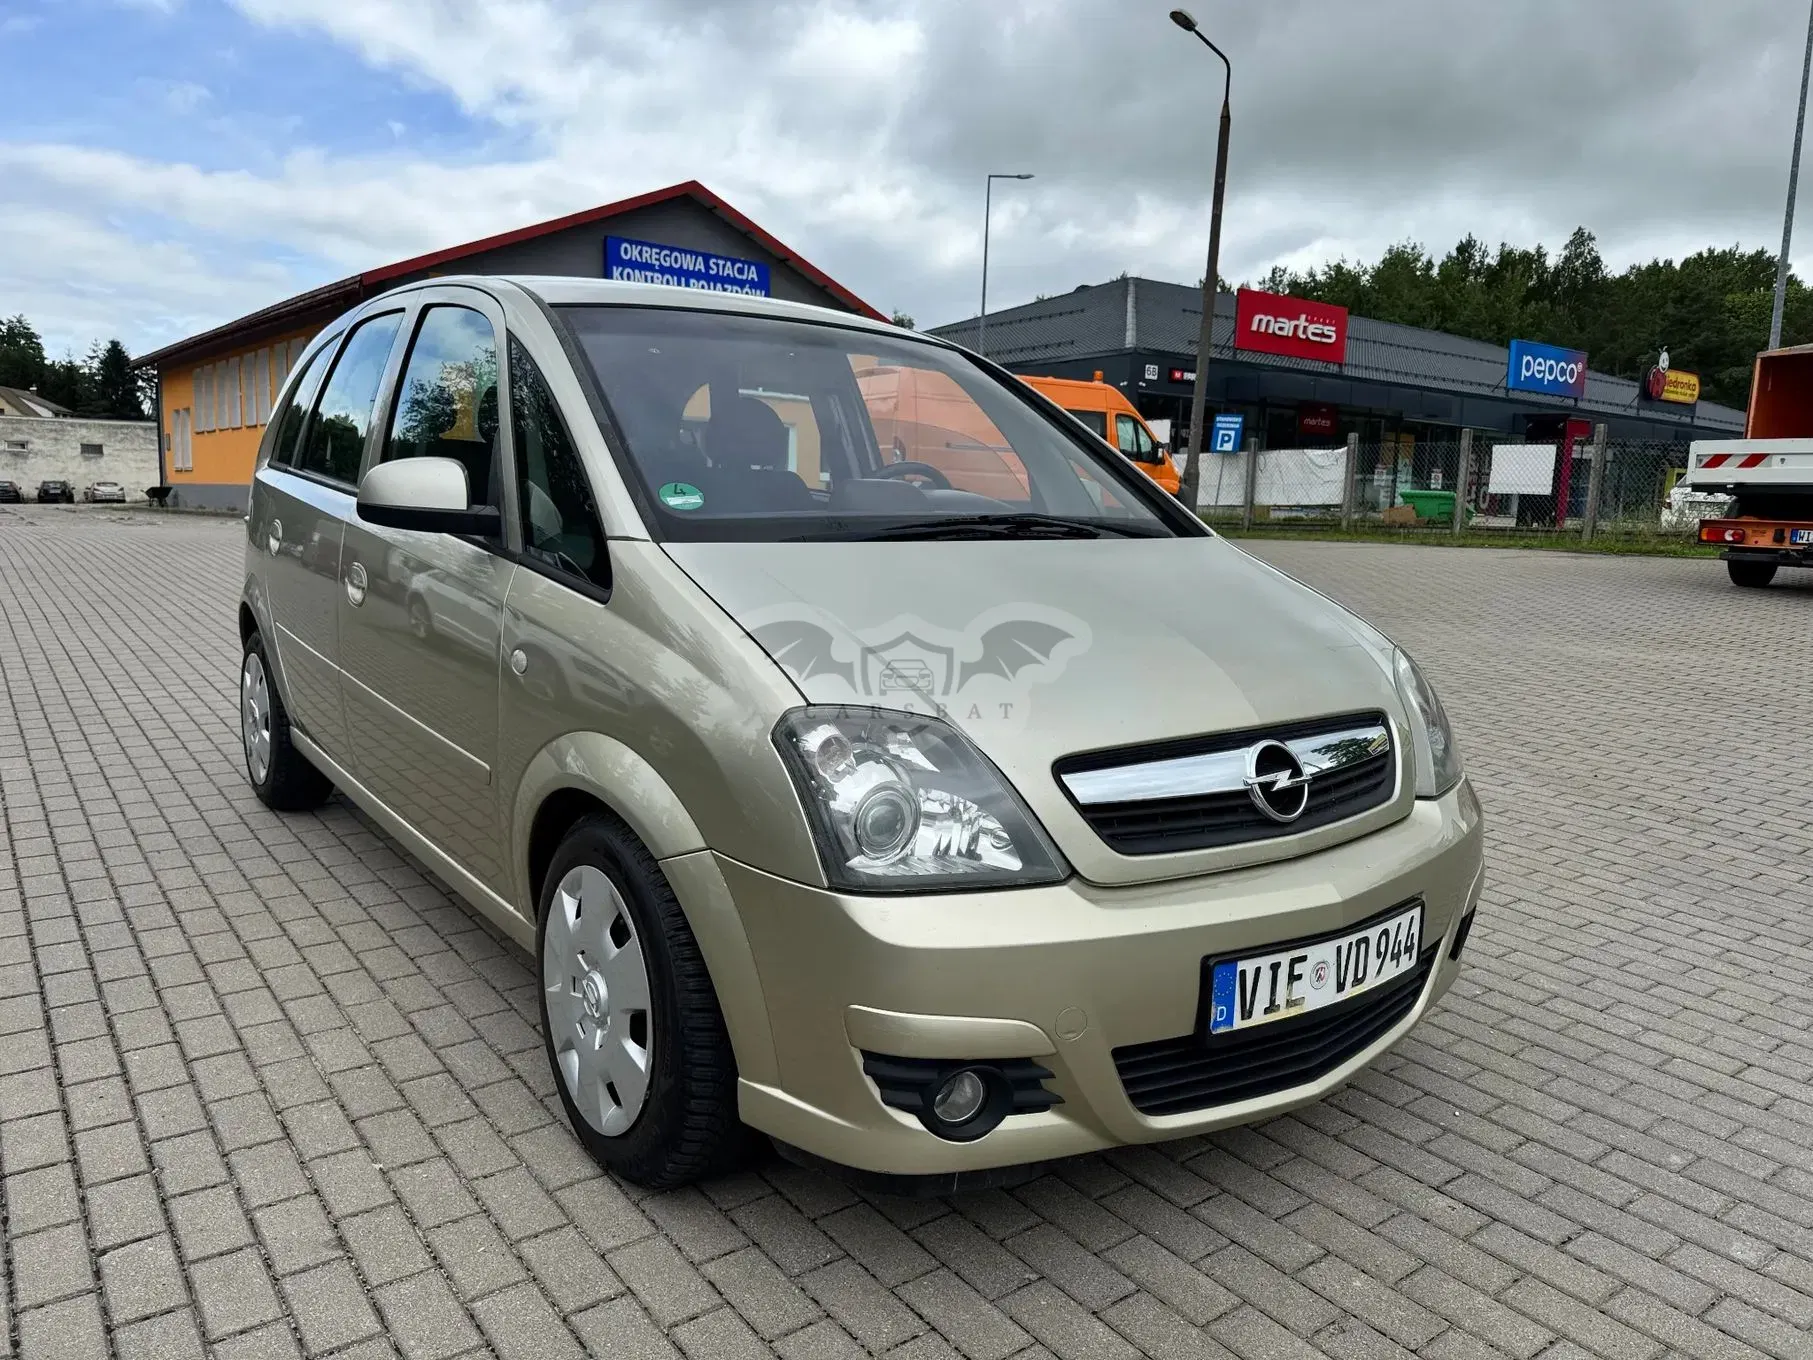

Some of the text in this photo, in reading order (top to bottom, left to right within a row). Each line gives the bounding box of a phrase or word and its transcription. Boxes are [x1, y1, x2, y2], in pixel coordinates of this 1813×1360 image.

[620, 243, 758, 281] OKRĘGOWA STACJA
[1251, 314, 1336, 343] martes
[1147, 366, 1156, 376] 6B
[1219, 433, 1232, 448] P
[674, 484, 686, 495] 4
[1216, 1006, 1227, 1021] D
[1239, 954, 1308, 1021] VIE
